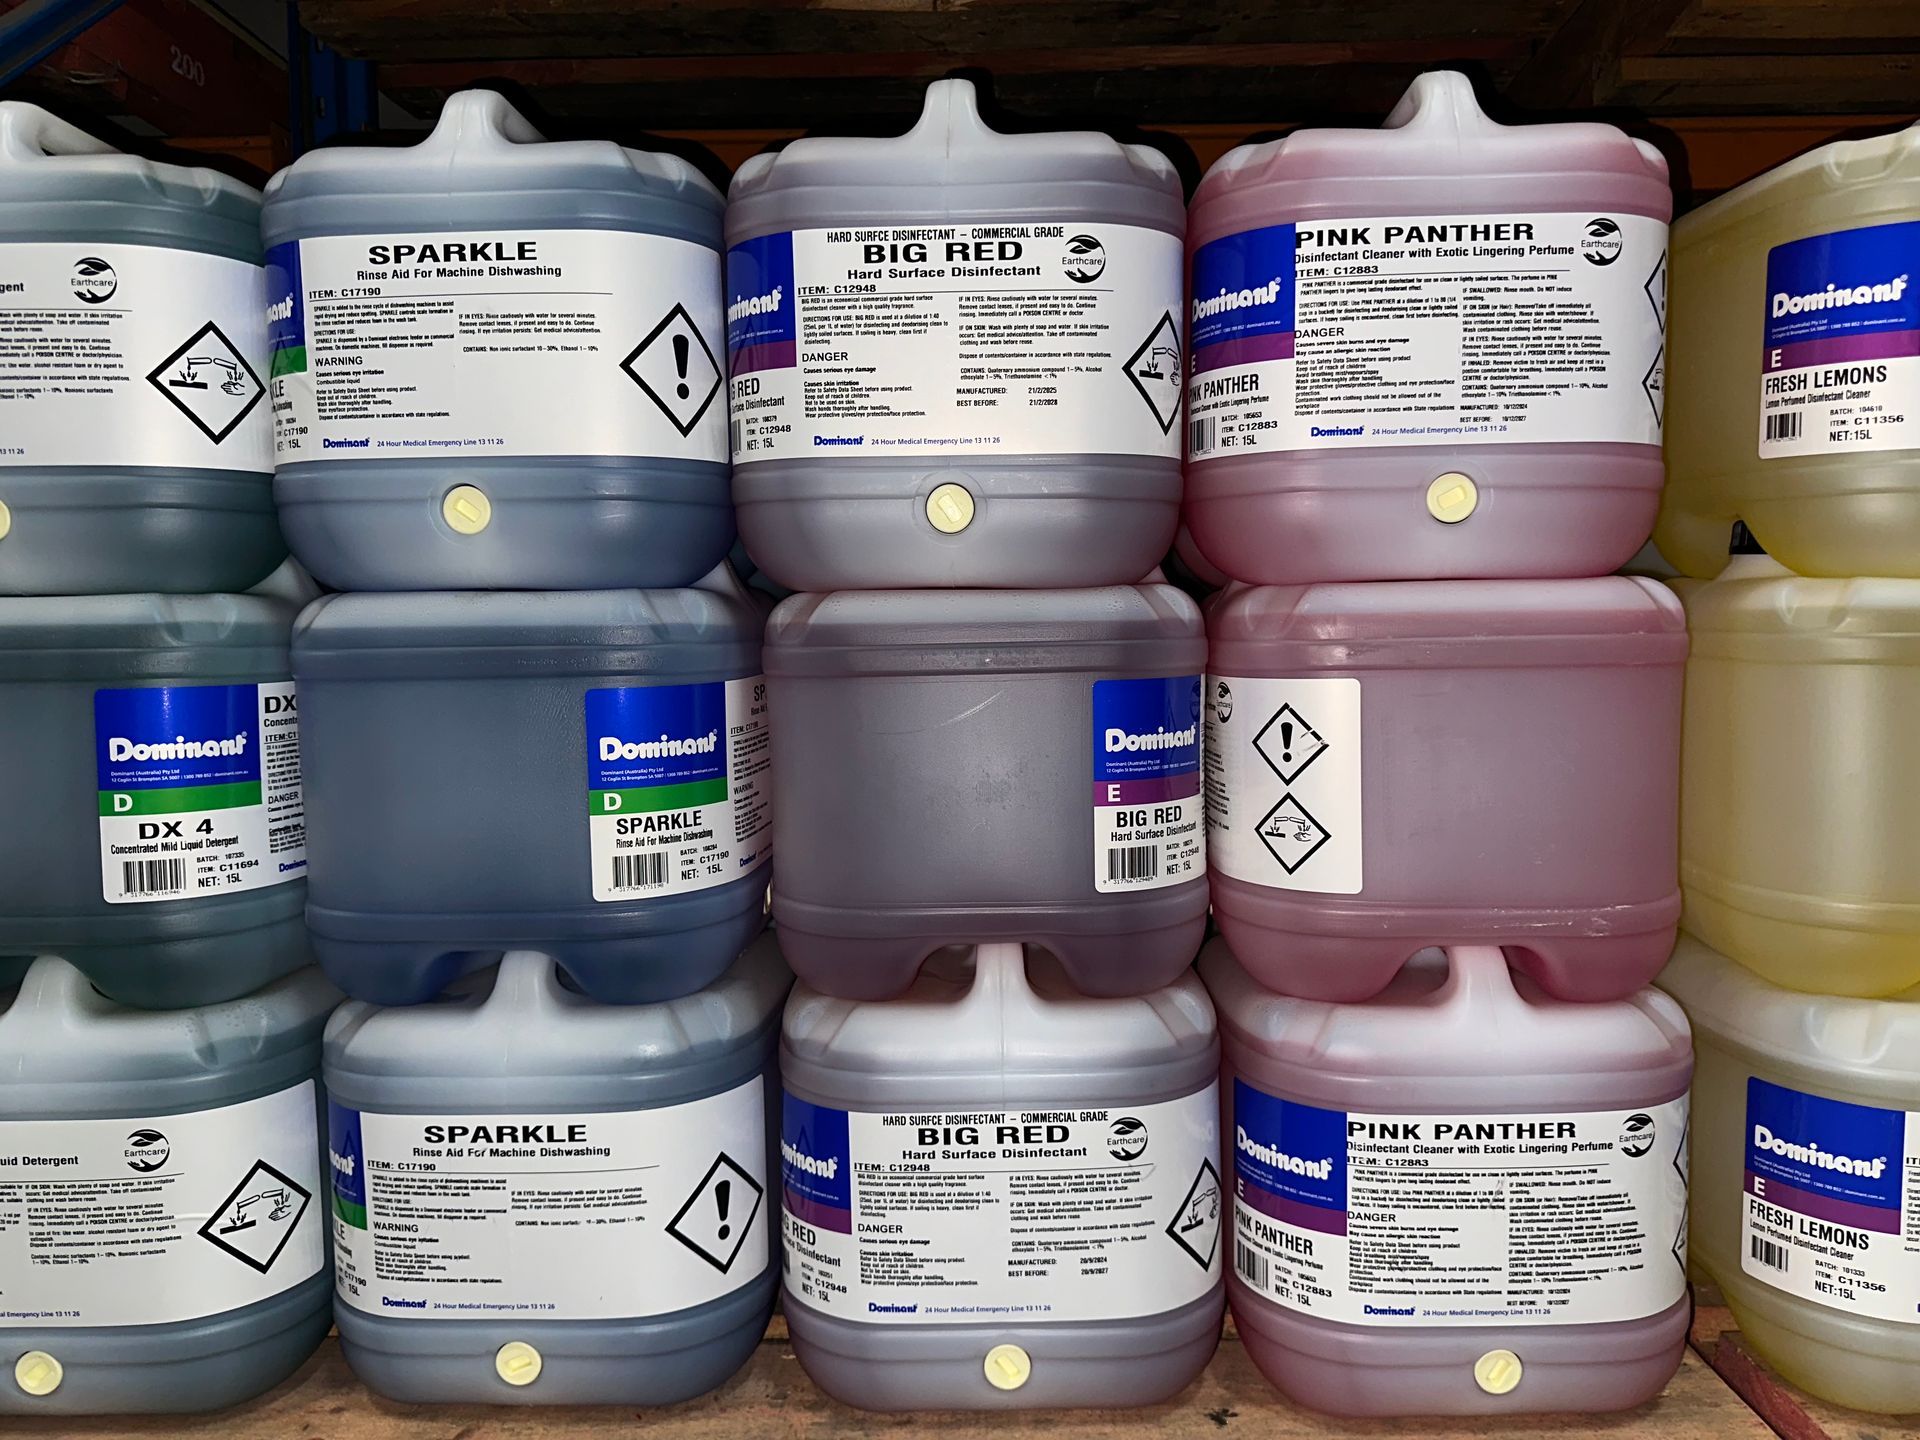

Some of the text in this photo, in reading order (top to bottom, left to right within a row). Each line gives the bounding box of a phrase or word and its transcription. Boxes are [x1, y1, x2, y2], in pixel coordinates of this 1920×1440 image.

[170, 45, 206, 87] 200
[827, 226, 1064, 243] HARD SURFCE DISINFECTANT COMMERCIAL GRADE
[1296, 223, 1533, 248] PINK PANTHER
[1581, 239, 1620, 249] Earthcare
[368, 241, 538, 265] SPARKLE
[863, 241, 1023, 264] BIG RED
[1294, 245, 1574, 264] Disinfectant Cleaner with Exotic Lingering Perfume
[1062, 257, 1103, 266] Earthcare
[357, 265, 562, 281] Rinse Aid For Machine Dishwashing
[847, 266, 1041, 280] Hard Surface Disinfectant
[1334, 265, 1379, 275] C12883
[71, 277, 114, 287] Earthcare
[309, 287, 381, 299] ITEM: C17190
[797, 284, 876, 295] ITEM: C12948
[1192, 279, 1281, 322] Dominant
[1773, 277, 1907, 318] Dominant
[1294, 328, 1345, 339] DANGER
[315, 356, 363, 367] WARNING
[802, 352, 848, 362] DANGER
[1771, 349, 1782, 368] E
[855, 366, 876, 374] damage
[1204, 373, 1259, 400] PANTHER
[1766, 365, 1887, 395] FRESH LEMONS
[738, 378, 760, 398] RED
[745, 396, 784, 409] Disinfectant
[1766, 389, 1871, 409] Lemon Perfumed Disinfectant Cleaner
[1238, 421, 1278, 432] C12883
[1830, 415, 1904, 427] ITEM: C11356
[284, 426, 308, 437] C17190
[760, 425, 791, 435] C12948
[1311, 426, 1363, 437] Dominant
[288, 439, 301, 449] 15L
[323, 437, 368, 449] Dominant
[403, 439, 427, 447] Medical
[428, 439, 462, 448] Emergency
[814, 436, 862, 446] Dominant
[1221, 435, 1257, 447] NET: 15L
[599, 731, 716, 761] Dominant
[1105, 726, 1196, 752] Dominant
[109, 734, 246, 762] Dominant
[268, 791, 299, 804] DANGER
[1107, 784, 1121, 802] E
[114, 794, 133, 812] D
[604, 793, 622, 811] D
[616, 810, 702, 835] SPARKLE
[1116, 805, 1182, 828] BIG RED
[138, 818, 214, 840] DX 4
[1111, 821, 1197, 842] Hard Surface Disinfectant
[111, 836, 239, 855] Concentrated Mild Liquid Detergent
[616, 829, 713, 849] Rinse Aid For Machine Dishwashing
[196, 855, 220, 863] BATCH:
[700, 851, 729, 864] C17190
[198, 860, 259, 874] ITEM: C11694
[681, 864, 723, 881] NET: 15L
[1166, 861, 1191, 875] NET: 15L
[198, 873, 242, 888] NET: 15L
[883, 1110, 1109, 1126] HARD SURFCE DISINFECTANT COMMERCIAL GRADE
[424, 1124, 587, 1144] SPARKLE
[918, 1125, 1070, 1146] BIG RED
[1348, 1121, 1576, 1140] PINK PANTHER
[1619, 1132, 1653, 1143] Earthcare
[1107, 1136, 1145, 1146] Earthcare
[1346, 1141, 1613, 1155] Disinfectant Cleaner Exotic Lingering Perfume
[124, 1147, 166, 1158] Earthcare
[413, 1146, 611, 1158] Rinse Aid Machine Dishwashing
[902, 1147, 1087, 1160] Hard Surface Disinfectant
[1238, 1125, 1332, 1180] Dominant
[1754, 1124, 1886, 1179] Dominant
[22, 1155, 79, 1168] Detergent
[397, 1162, 436, 1171] C17190
[889, 1163, 930, 1172] C12948
[1385, 1157, 1429, 1167] C12883
[1754, 1176, 1766, 1197] E
[1347, 1211, 1396, 1222] DANGER
[373, 1221, 419, 1233] WARNING
[857, 1223, 903, 1234] DANGER
[1750, 1199, 1870, 1251] FRESH LEMONS
[1255, 1220, 1313, 1256] PANTHER
[1292, 1280, 1332, 1298] C12883
[1838, 1275, 1886, 1293] C11356
[382, 1297, 427, 1309] Dominant
